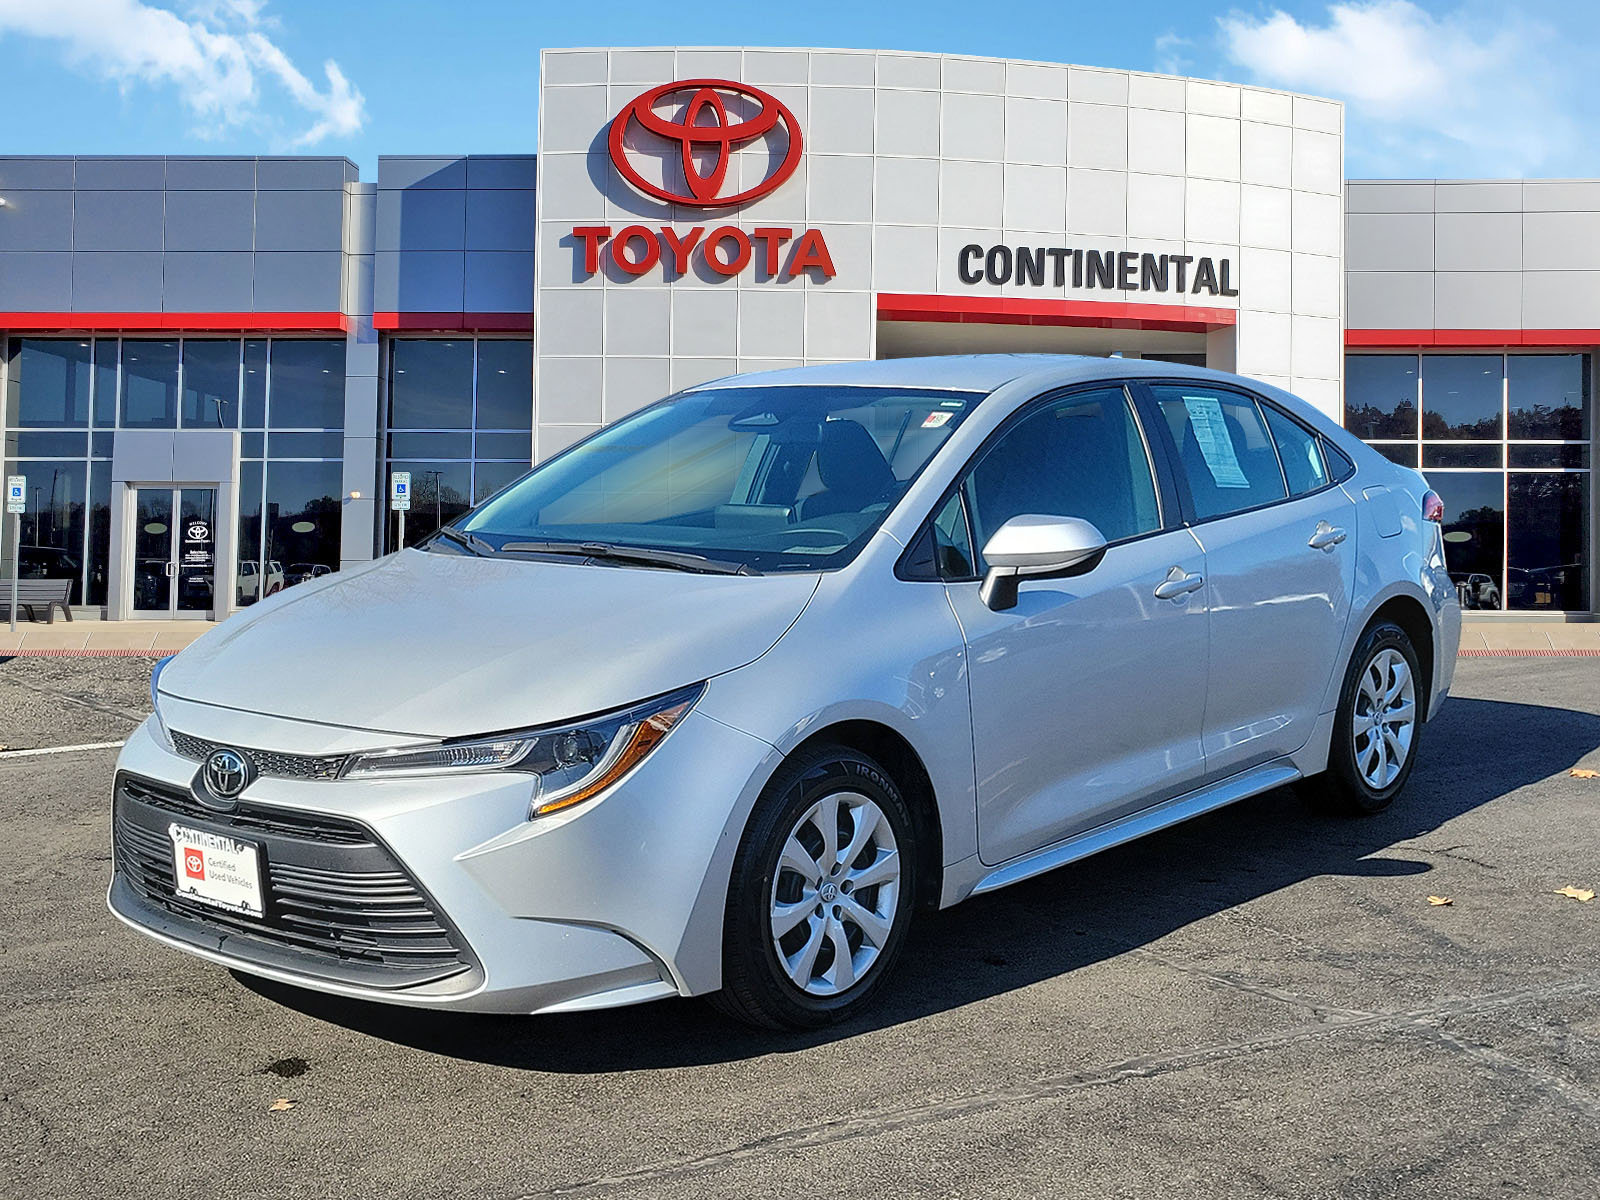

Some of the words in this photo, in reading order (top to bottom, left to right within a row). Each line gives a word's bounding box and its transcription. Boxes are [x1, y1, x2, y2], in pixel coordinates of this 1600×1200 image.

[572, 225, 837, 276] TOYOTA
[958, 244, 1239, 297] CONTINENTAL
[208, 857, 236, 872] Certified
[209, 869, 226, 882] Used
[226, 874, 253, 889] Vehicles
